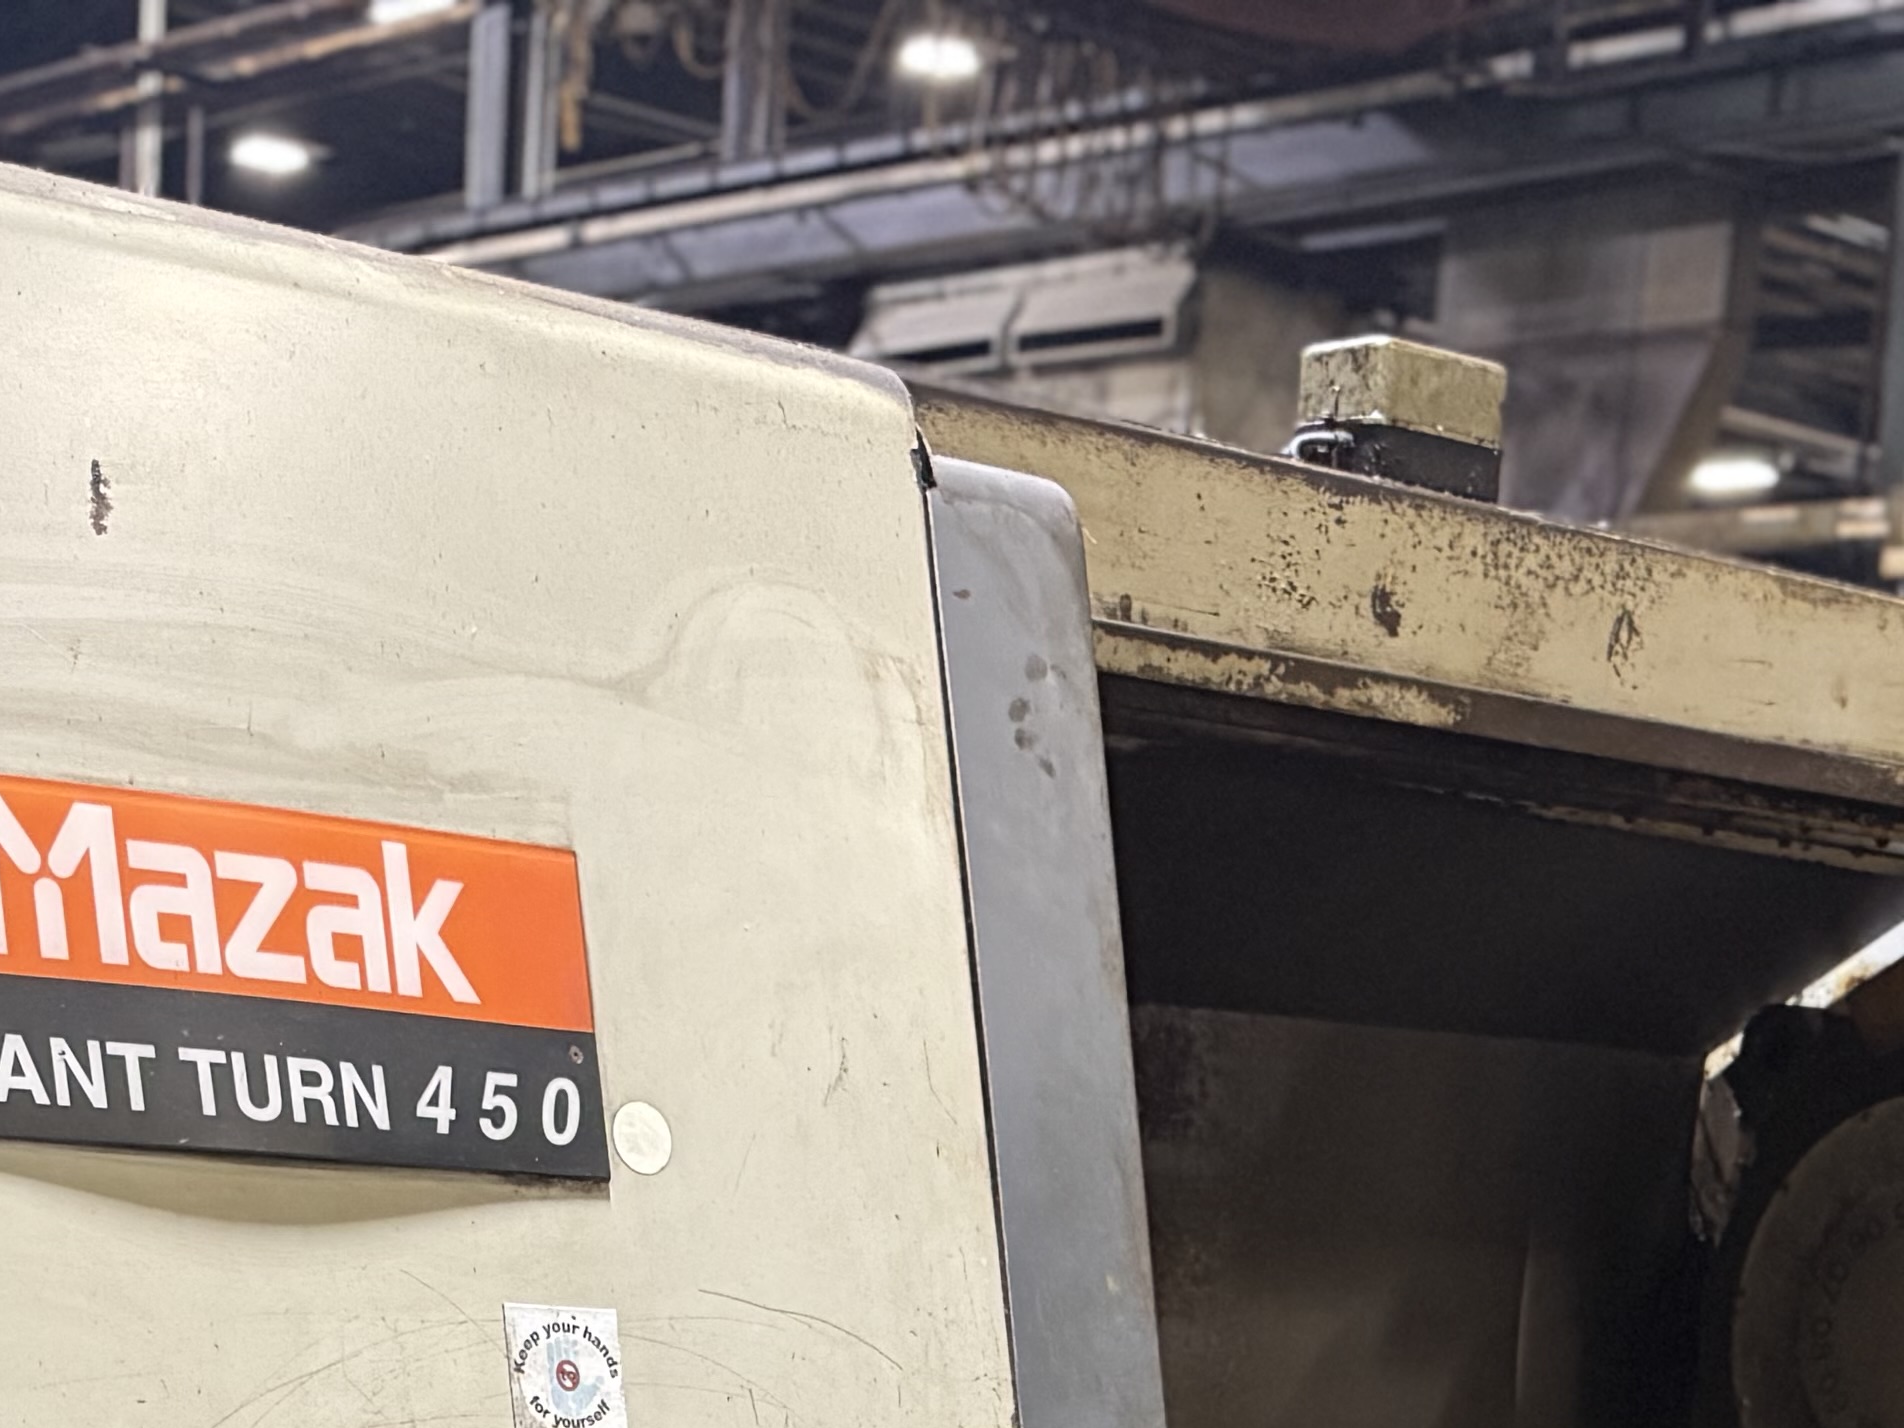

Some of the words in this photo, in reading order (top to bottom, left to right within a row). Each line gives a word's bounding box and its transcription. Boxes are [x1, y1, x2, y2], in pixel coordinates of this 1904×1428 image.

[178, 1047, 391, 1131] TURN
[513, 1331, 540, 1374] Keep
[542, 1321, 580, 1339] your
[582, 1326, 618, 1378] hands
[529, 1395, 551, 1418] for
[552, 1399, 611, 1428] yourself
